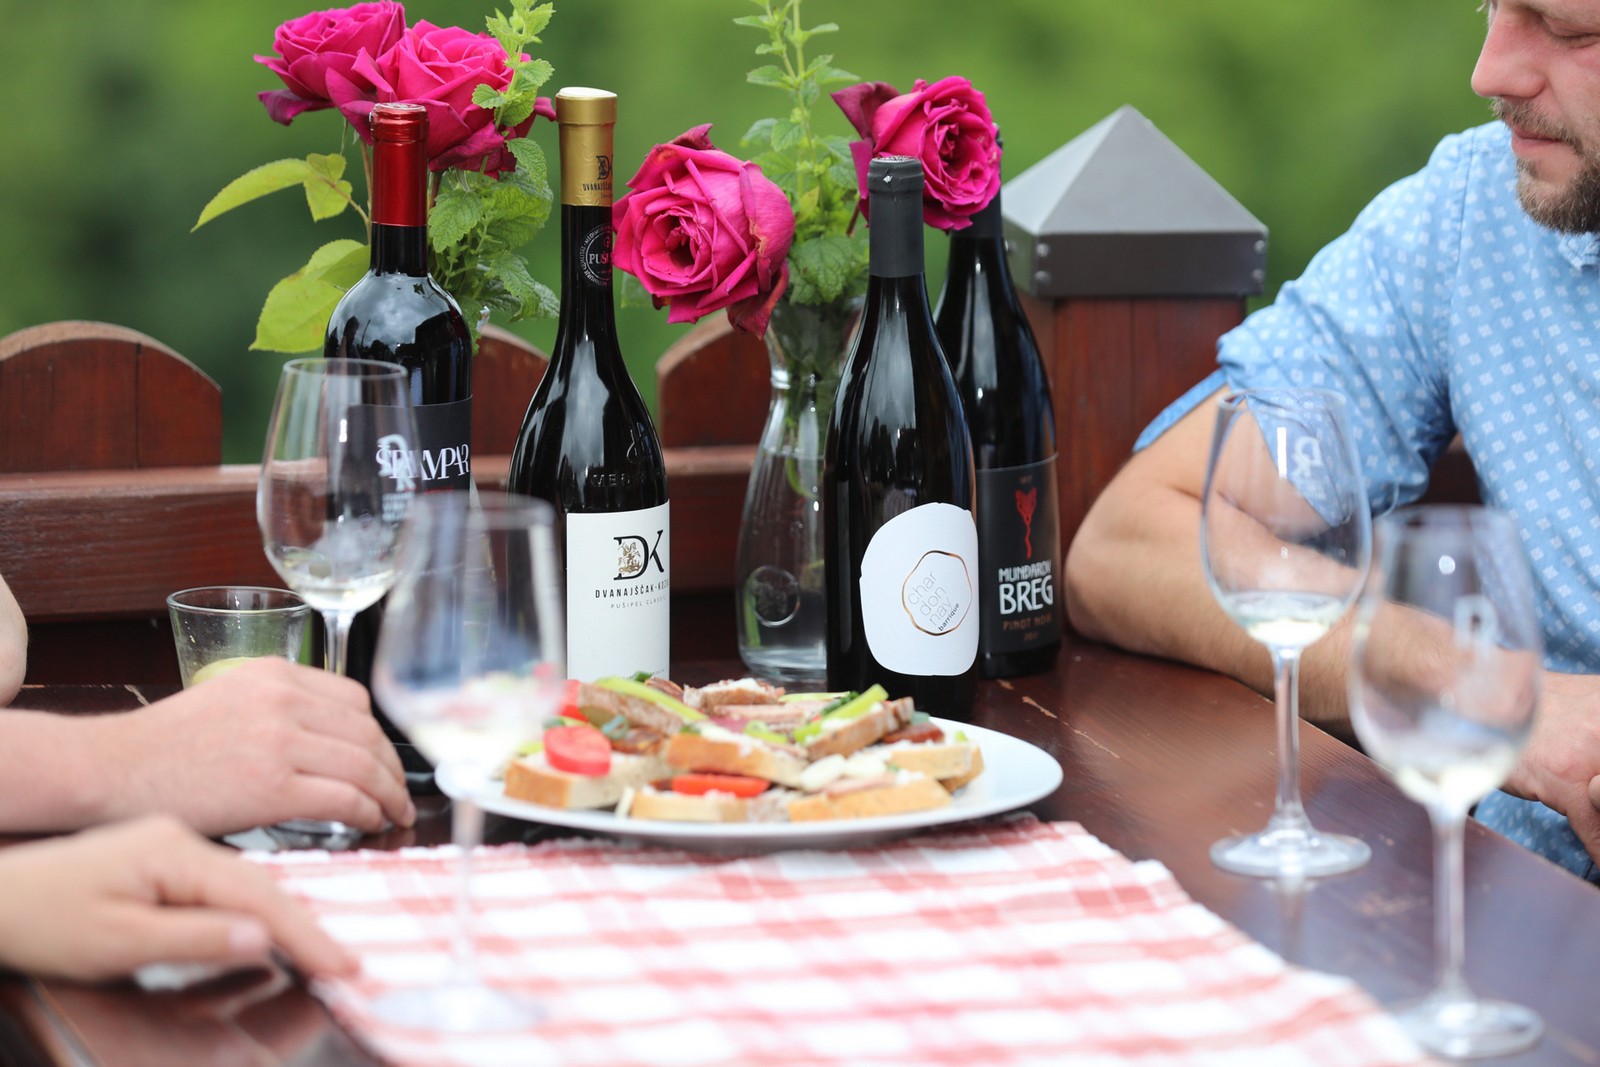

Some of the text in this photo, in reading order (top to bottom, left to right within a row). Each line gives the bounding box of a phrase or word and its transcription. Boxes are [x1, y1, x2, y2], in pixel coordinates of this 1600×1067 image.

[613, 530, 664, 580] DK
[908, 570, 937, 605] char
[919, 586, 947, 616] don
[999, 574, 1054, 615] BREG
[611, 600, 642, 609] PUŠIPEL
[929, 597, 953, 626] nay
[938, 603, 959, 632] barrique
